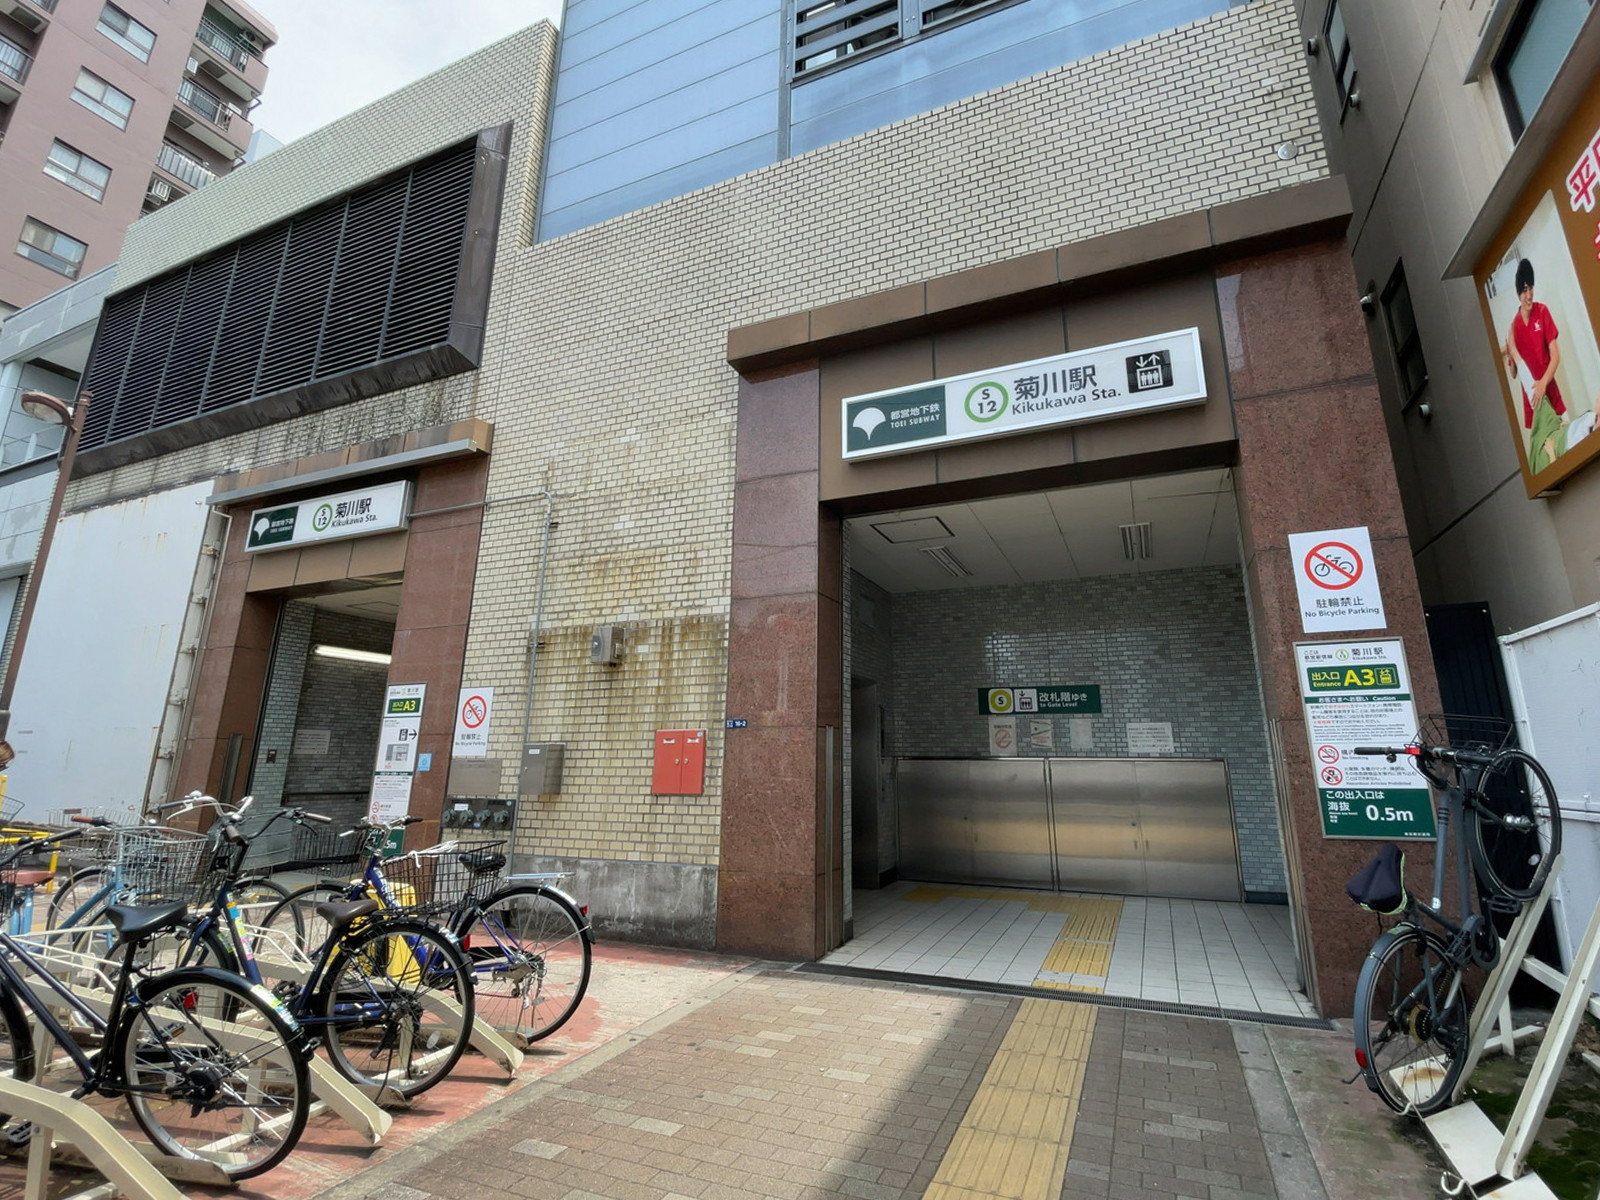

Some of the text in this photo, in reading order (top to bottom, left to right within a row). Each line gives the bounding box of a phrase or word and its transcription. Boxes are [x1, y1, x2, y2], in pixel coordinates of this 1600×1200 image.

[1014, 364, 1098, 402] 菊川駅
[981, 388, 990, 400] S
[1011, 386, 1122, 415] Kikukawa Sta.
[890, 403, 940, 421] 都営地下鉄
[977, 400, 997, 414] 12
[890, 414, 940, 429] TOEI SUBWAY
[335, 497, 372, 519] 菊川駅
[317, 516, 327, 526] 12
[331, 517, 364, 528] Kikukawa
[1316, 596, 1364, 609] 駐輪禁止
[1319, 608, 1346, 617] Bicycle
[1349, 606, 1380, 616] Parking
[1311, 671, 1340, 681] 出入口
[1344, 668, 1376, 687] A3
[1312, 680, 1342, 688] Entrance
[403, 700, 416, 711] A3
[997, 696, 1004, 705] S
[1325, 790, 1385, 800] この出入口は
[1327, 801, 1351, 811] 海抜
[1365, 804, 1415, 822] 0.5m
